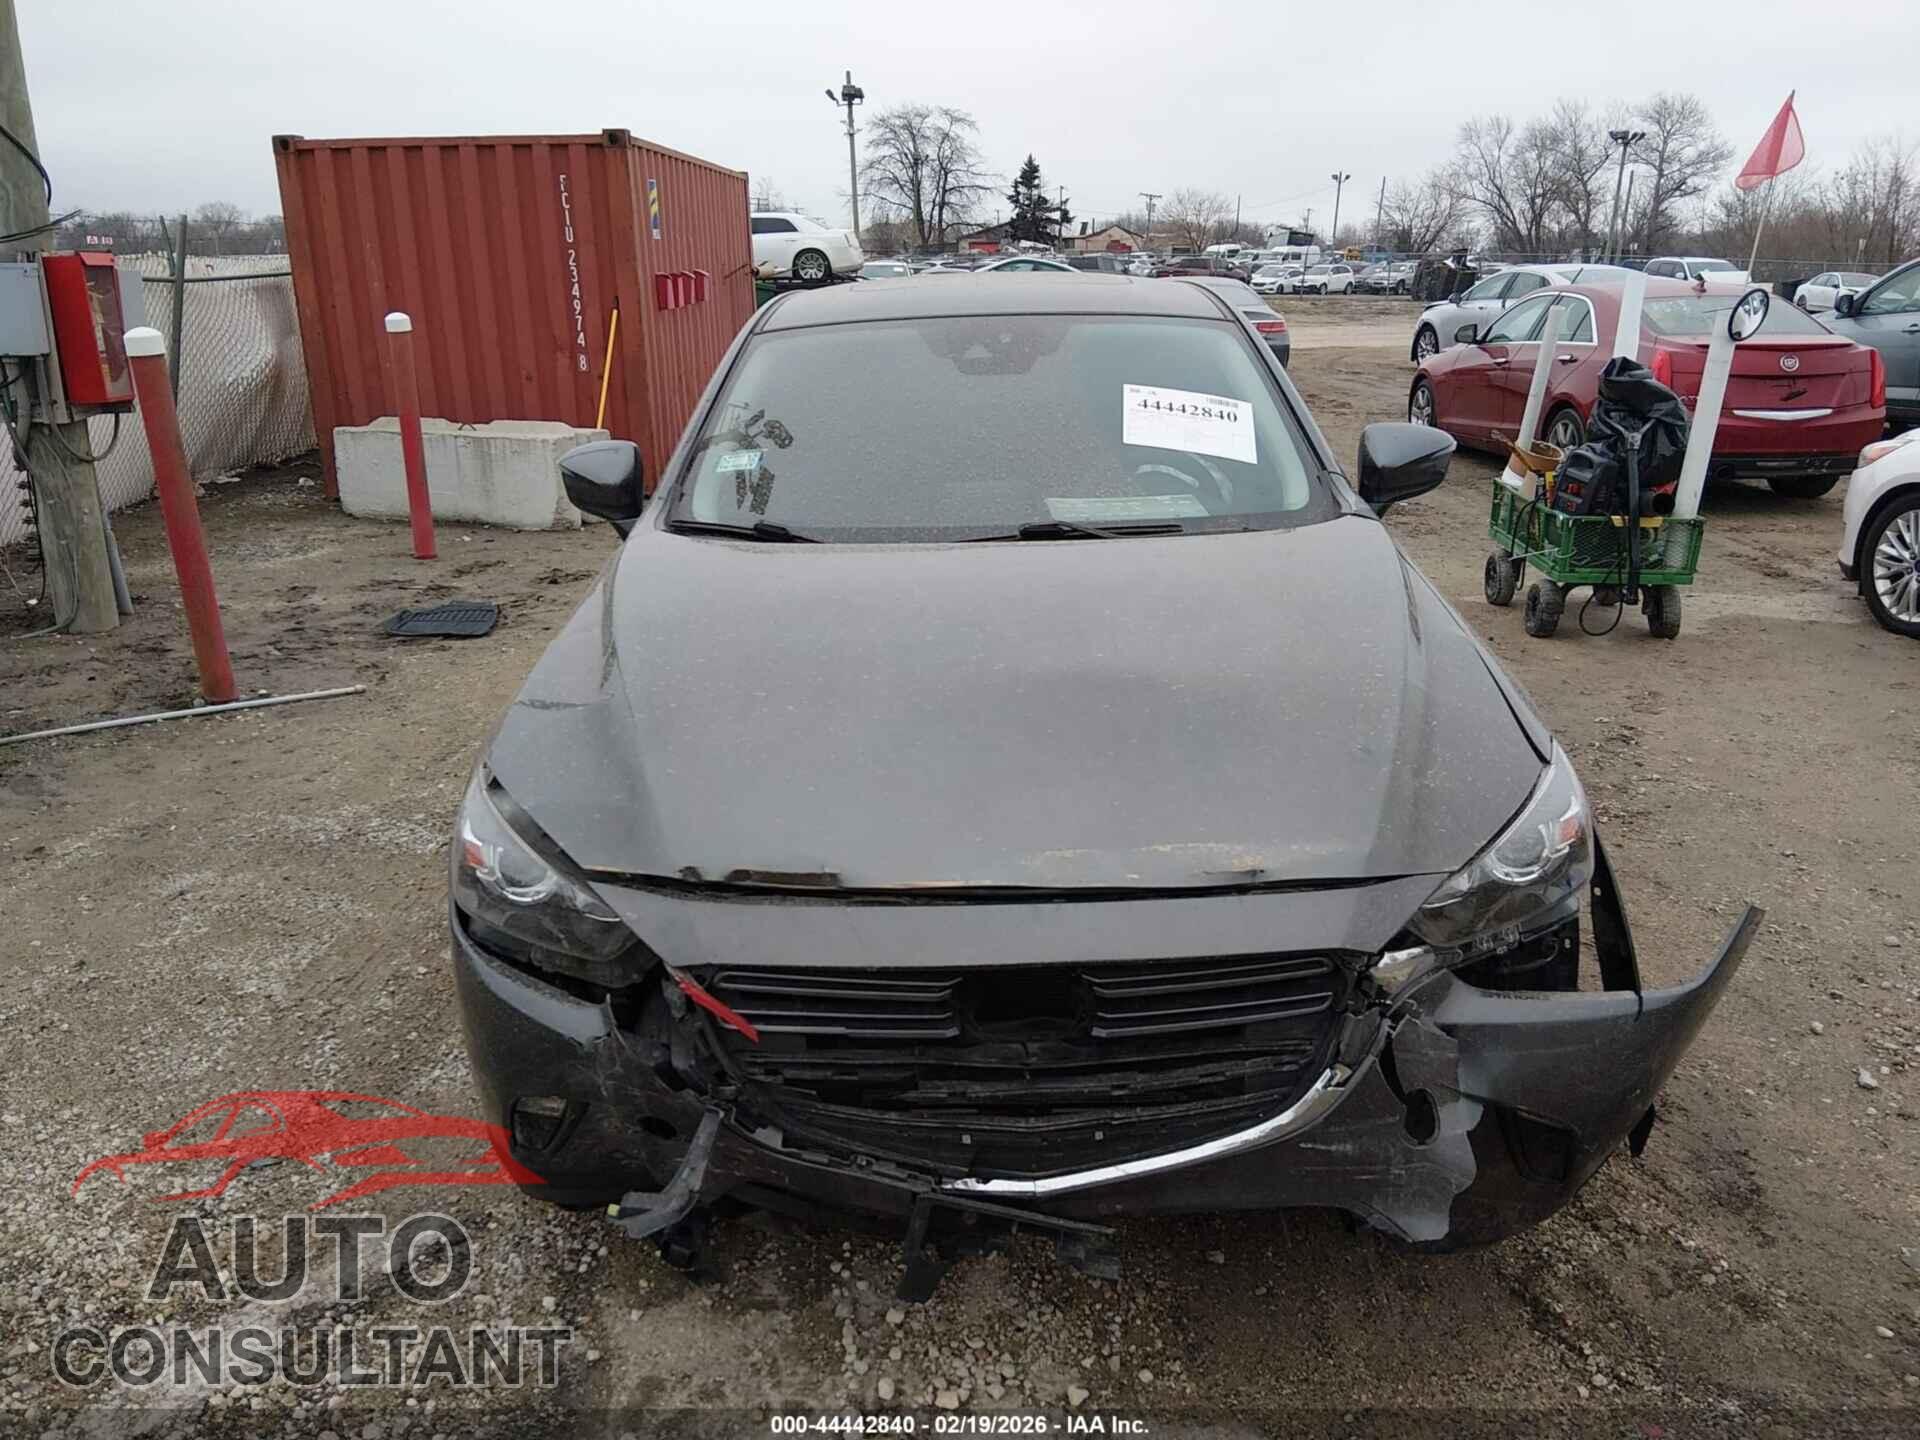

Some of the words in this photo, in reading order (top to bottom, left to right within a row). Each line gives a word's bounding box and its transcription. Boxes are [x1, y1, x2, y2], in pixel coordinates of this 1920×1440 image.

[568, 250, 585, 347] 234974
[578, 354, 588, 371] 8
[1137, 399, 1239, 423] 44442840
